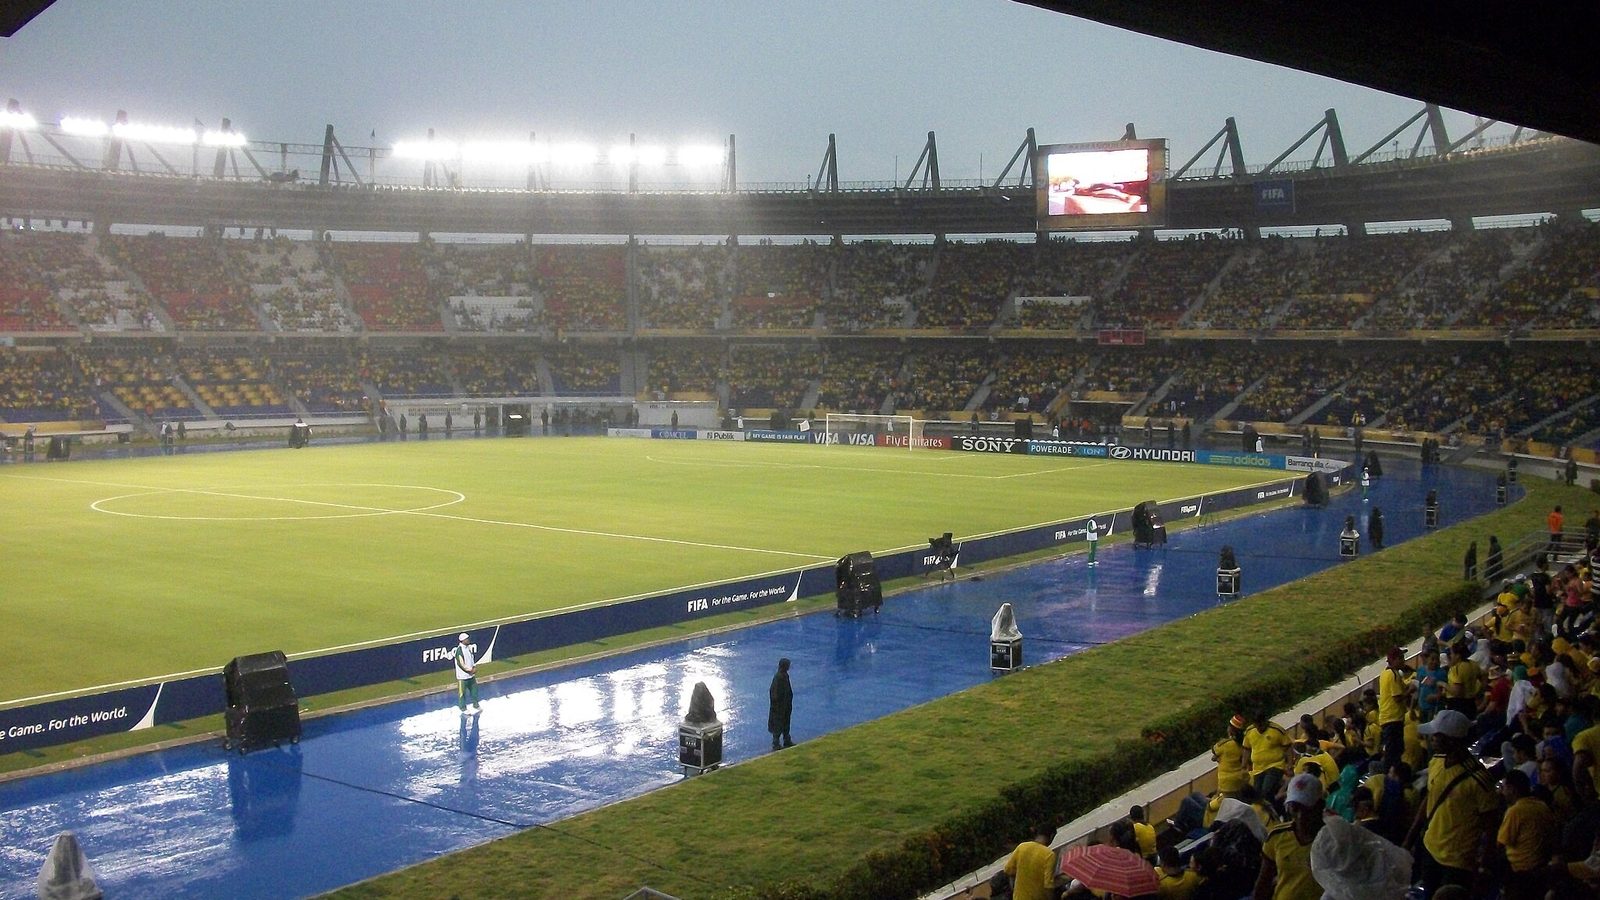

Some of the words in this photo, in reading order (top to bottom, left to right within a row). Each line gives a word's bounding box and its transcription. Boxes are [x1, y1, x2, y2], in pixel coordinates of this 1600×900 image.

[1262, 188, 1285, 199] FIFA
[714, 432, 735, 440] Publik
[814, 432, 840, 444] VISA
[848, 433, 876, 446] VISA
[886, 434, 901, 447] Fly
[962, 439, 1015, 452] SONY
[1031, 444, 1072, 454] POWERADE
[1133, 448, 1195, 462] HYUNDAI
[1233, 454, 1271, 466] adidas
[687, 598, 709, 613] FIFA
[711, 598, 721, 607] For
[721, 595, 731, 605] the
[732, 593, 749, 603] Game.
[749, 590, 759, 600] For
[758, 588, 769, 598] the
[8, 723, 46, 738] Game.
[48, 719, 67, 731] For
[69, 714, 89, 727] the
[91, 706, 128, 723] World.
